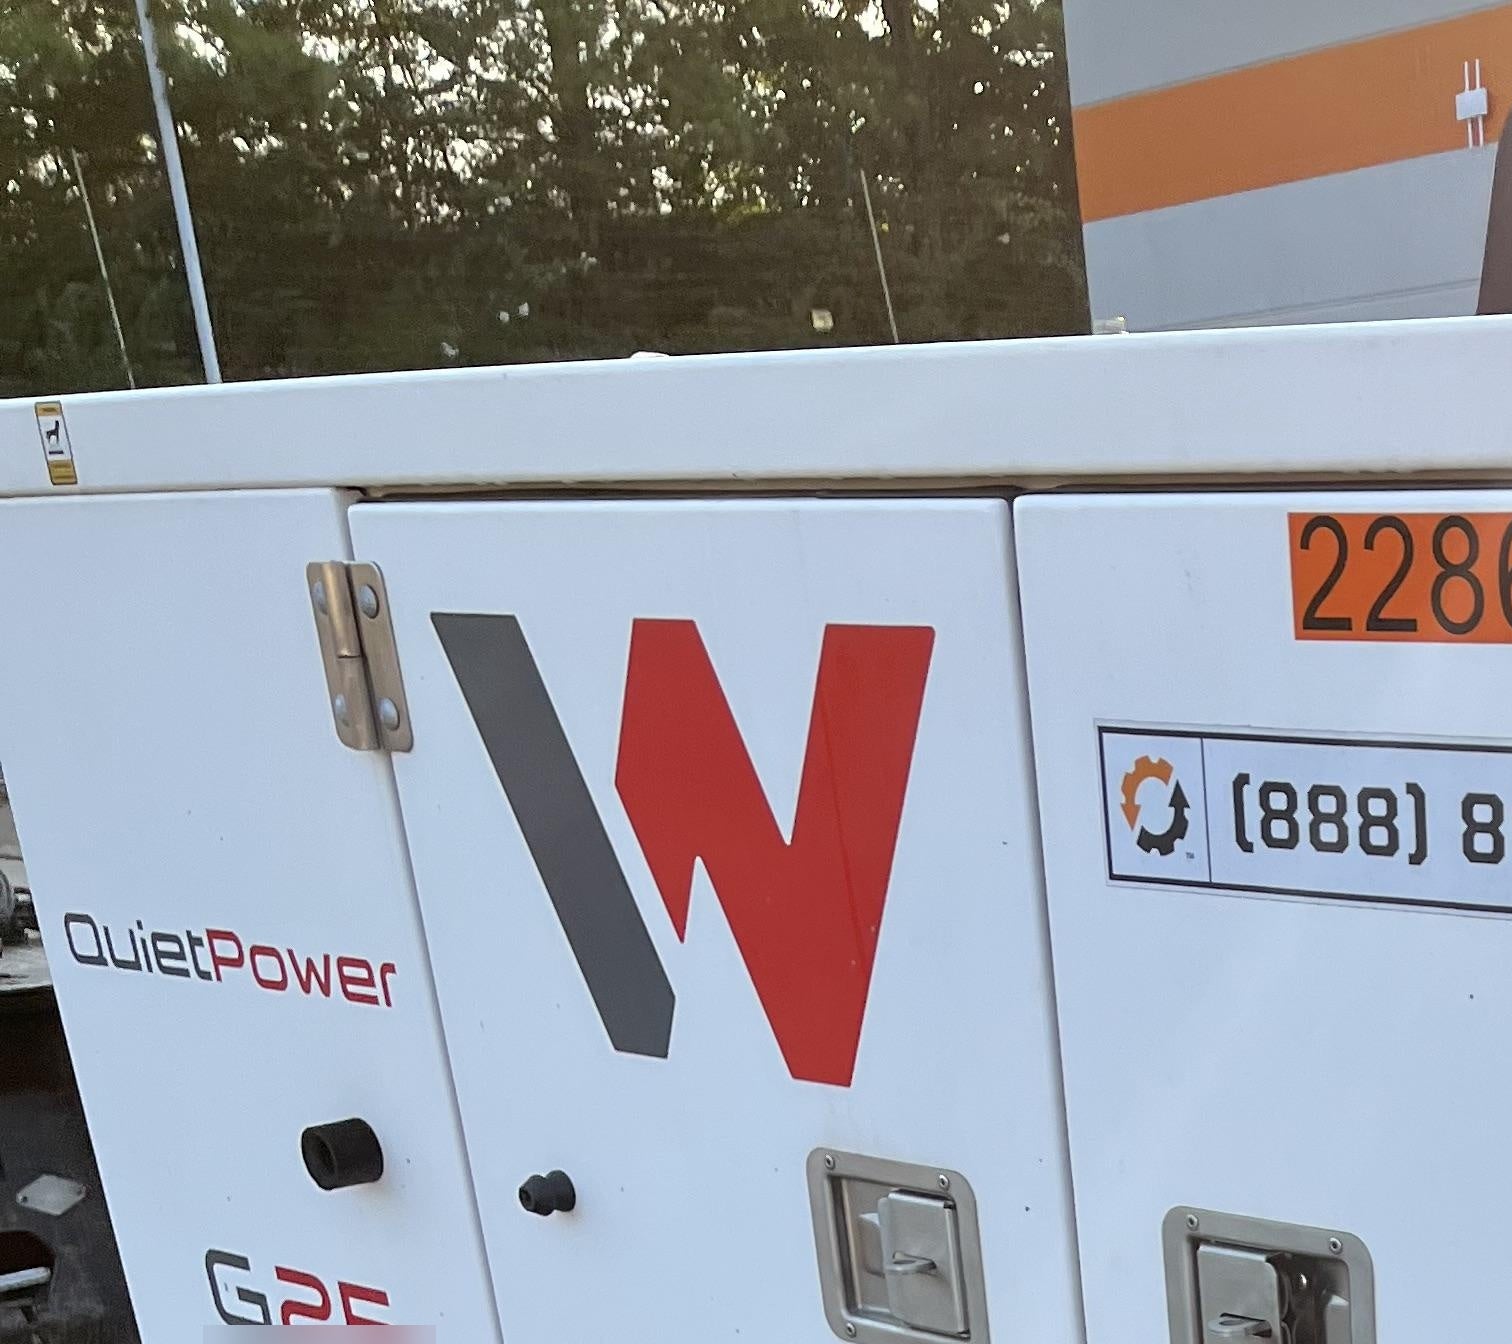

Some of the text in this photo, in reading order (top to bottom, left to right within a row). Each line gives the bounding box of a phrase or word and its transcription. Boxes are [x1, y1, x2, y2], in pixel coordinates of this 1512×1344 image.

[431, 612, 936, 1088] W
[1233, 772, 1427, 866] (888)
[64, 912, 396, 1008] QuietPower
